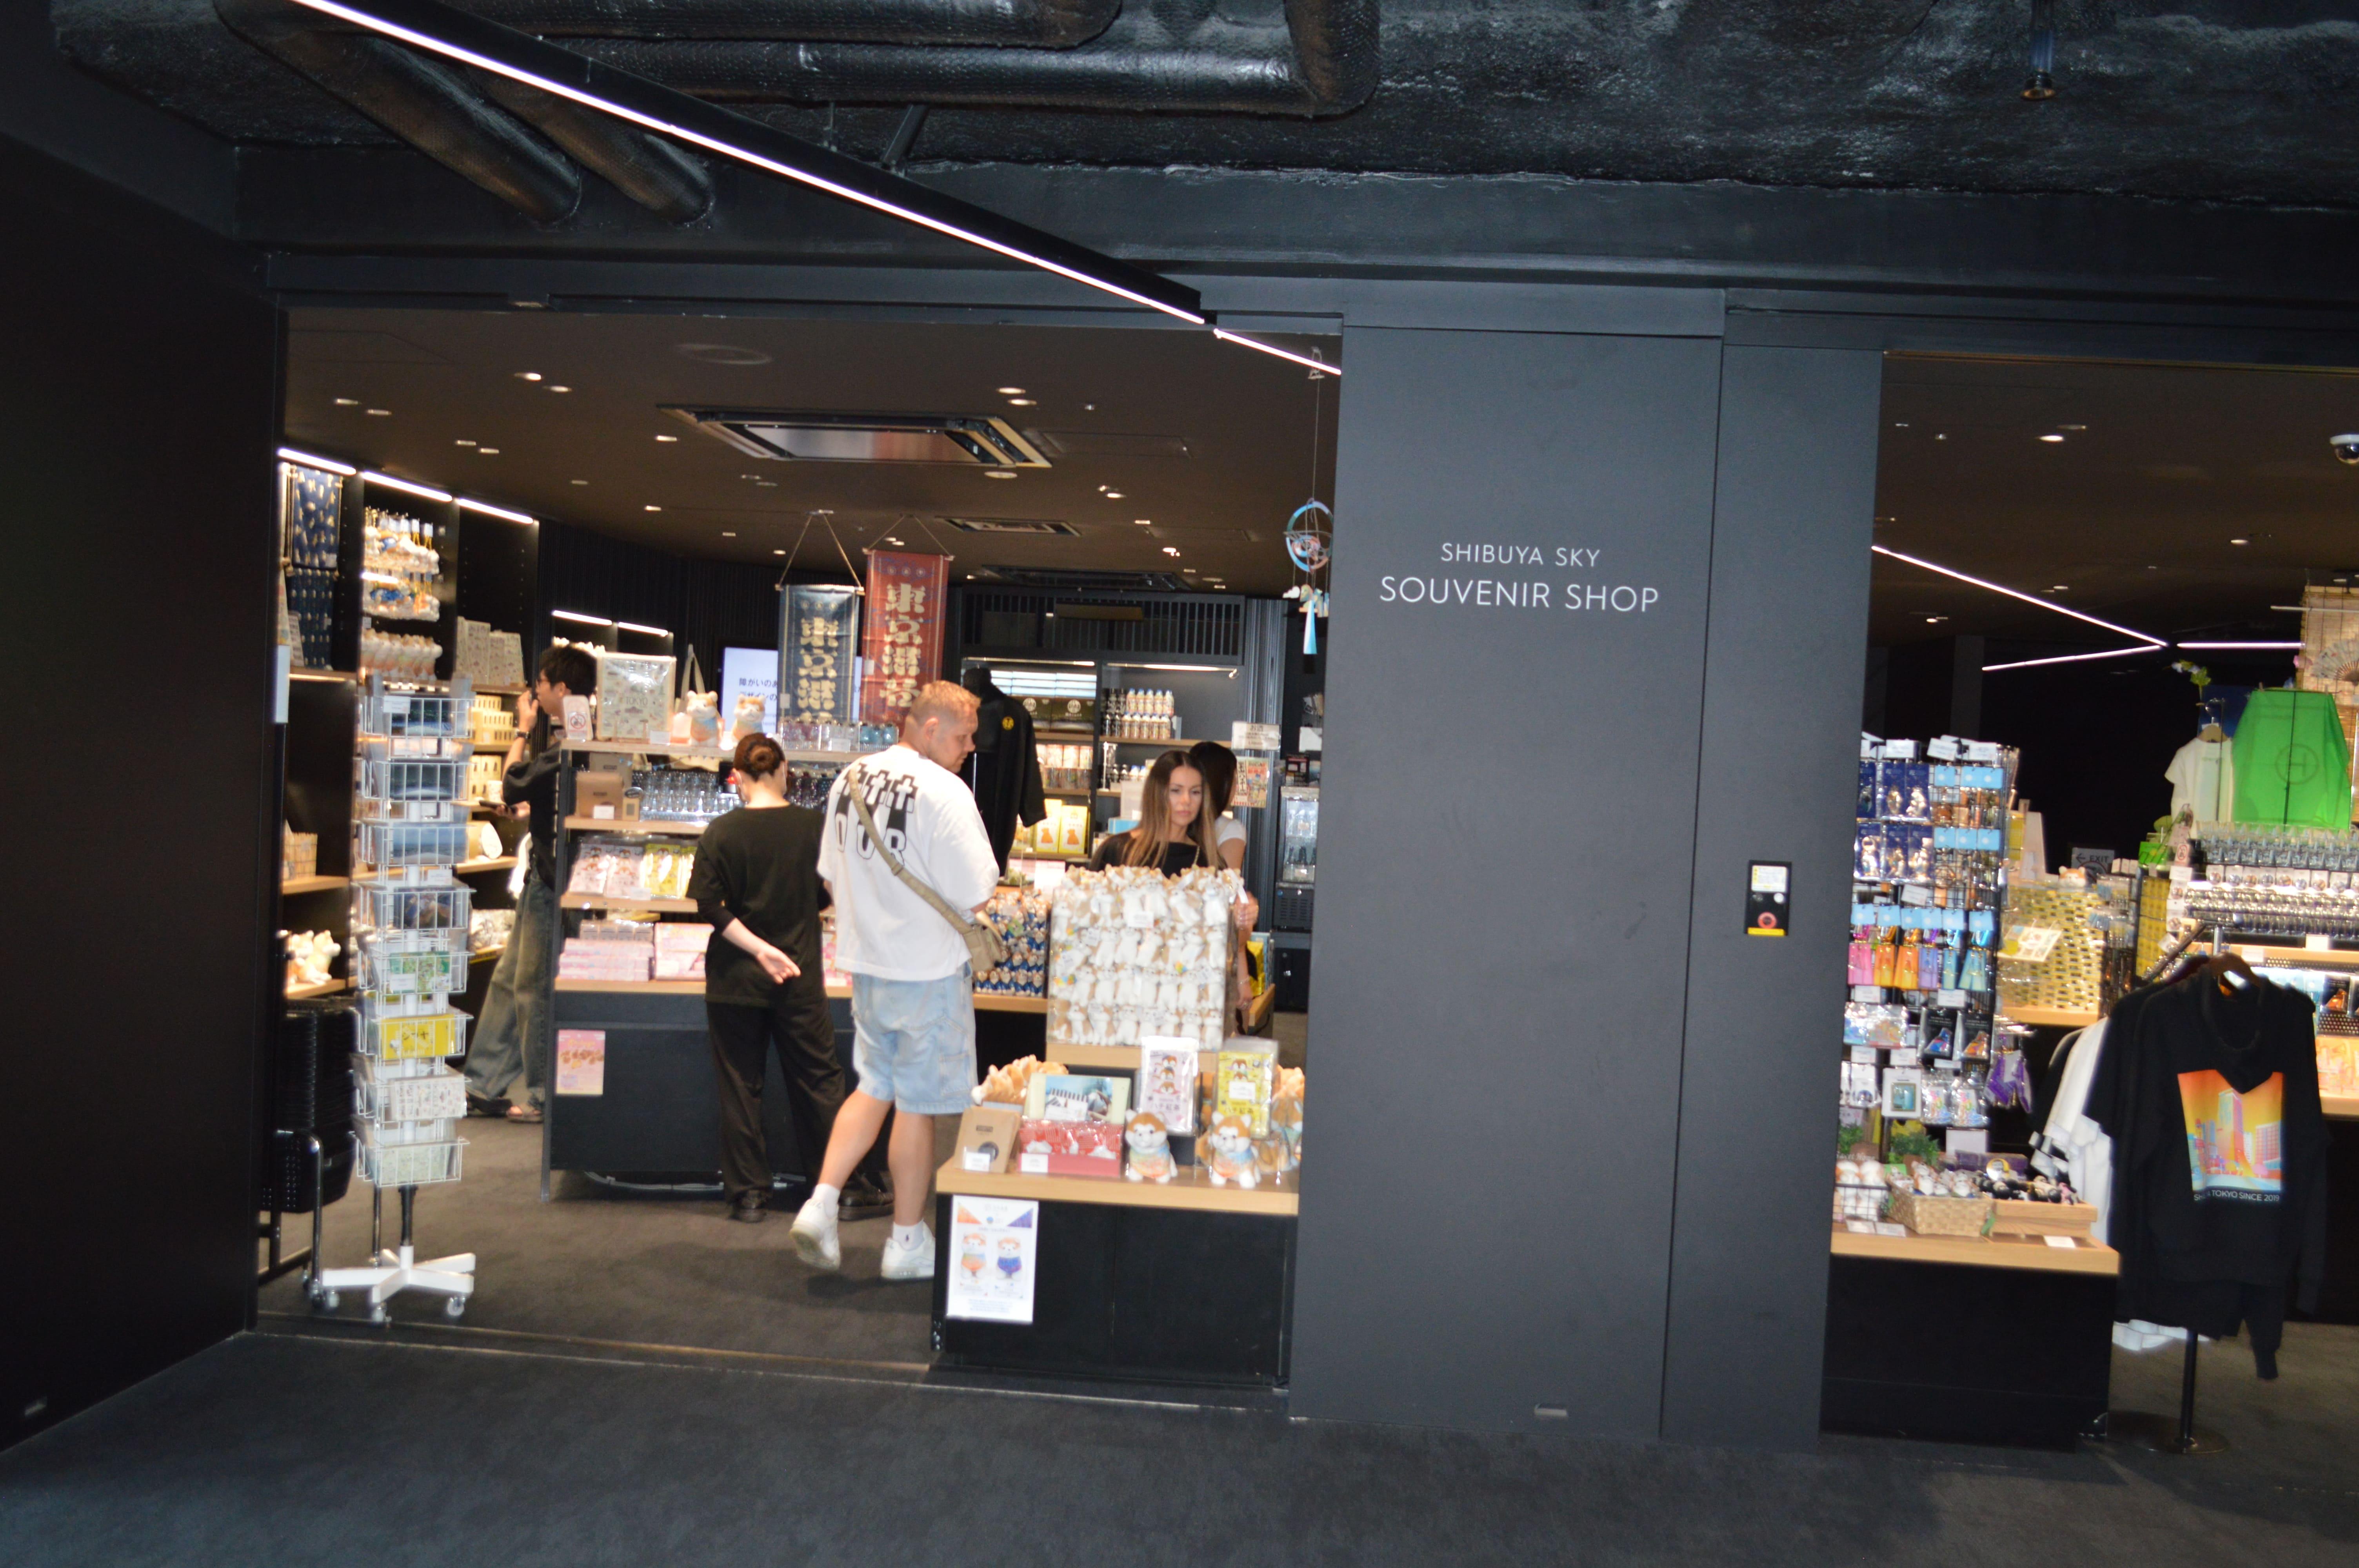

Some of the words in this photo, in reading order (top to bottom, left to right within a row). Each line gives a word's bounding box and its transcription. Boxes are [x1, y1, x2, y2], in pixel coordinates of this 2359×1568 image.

[1441, 543, 1544, 565] SHIBUYA
[1555, 547, 1600, 567] SKY
[1380, 576, 1550, 608] SOUVENIR
[1565, 584, 1659, 612] SHOP
[626, 697, 648, 706] TOKYO
[2211, 1190, 2238, 1198] TOKYO
[2239, 1192, 2263, 1201] SINCE
